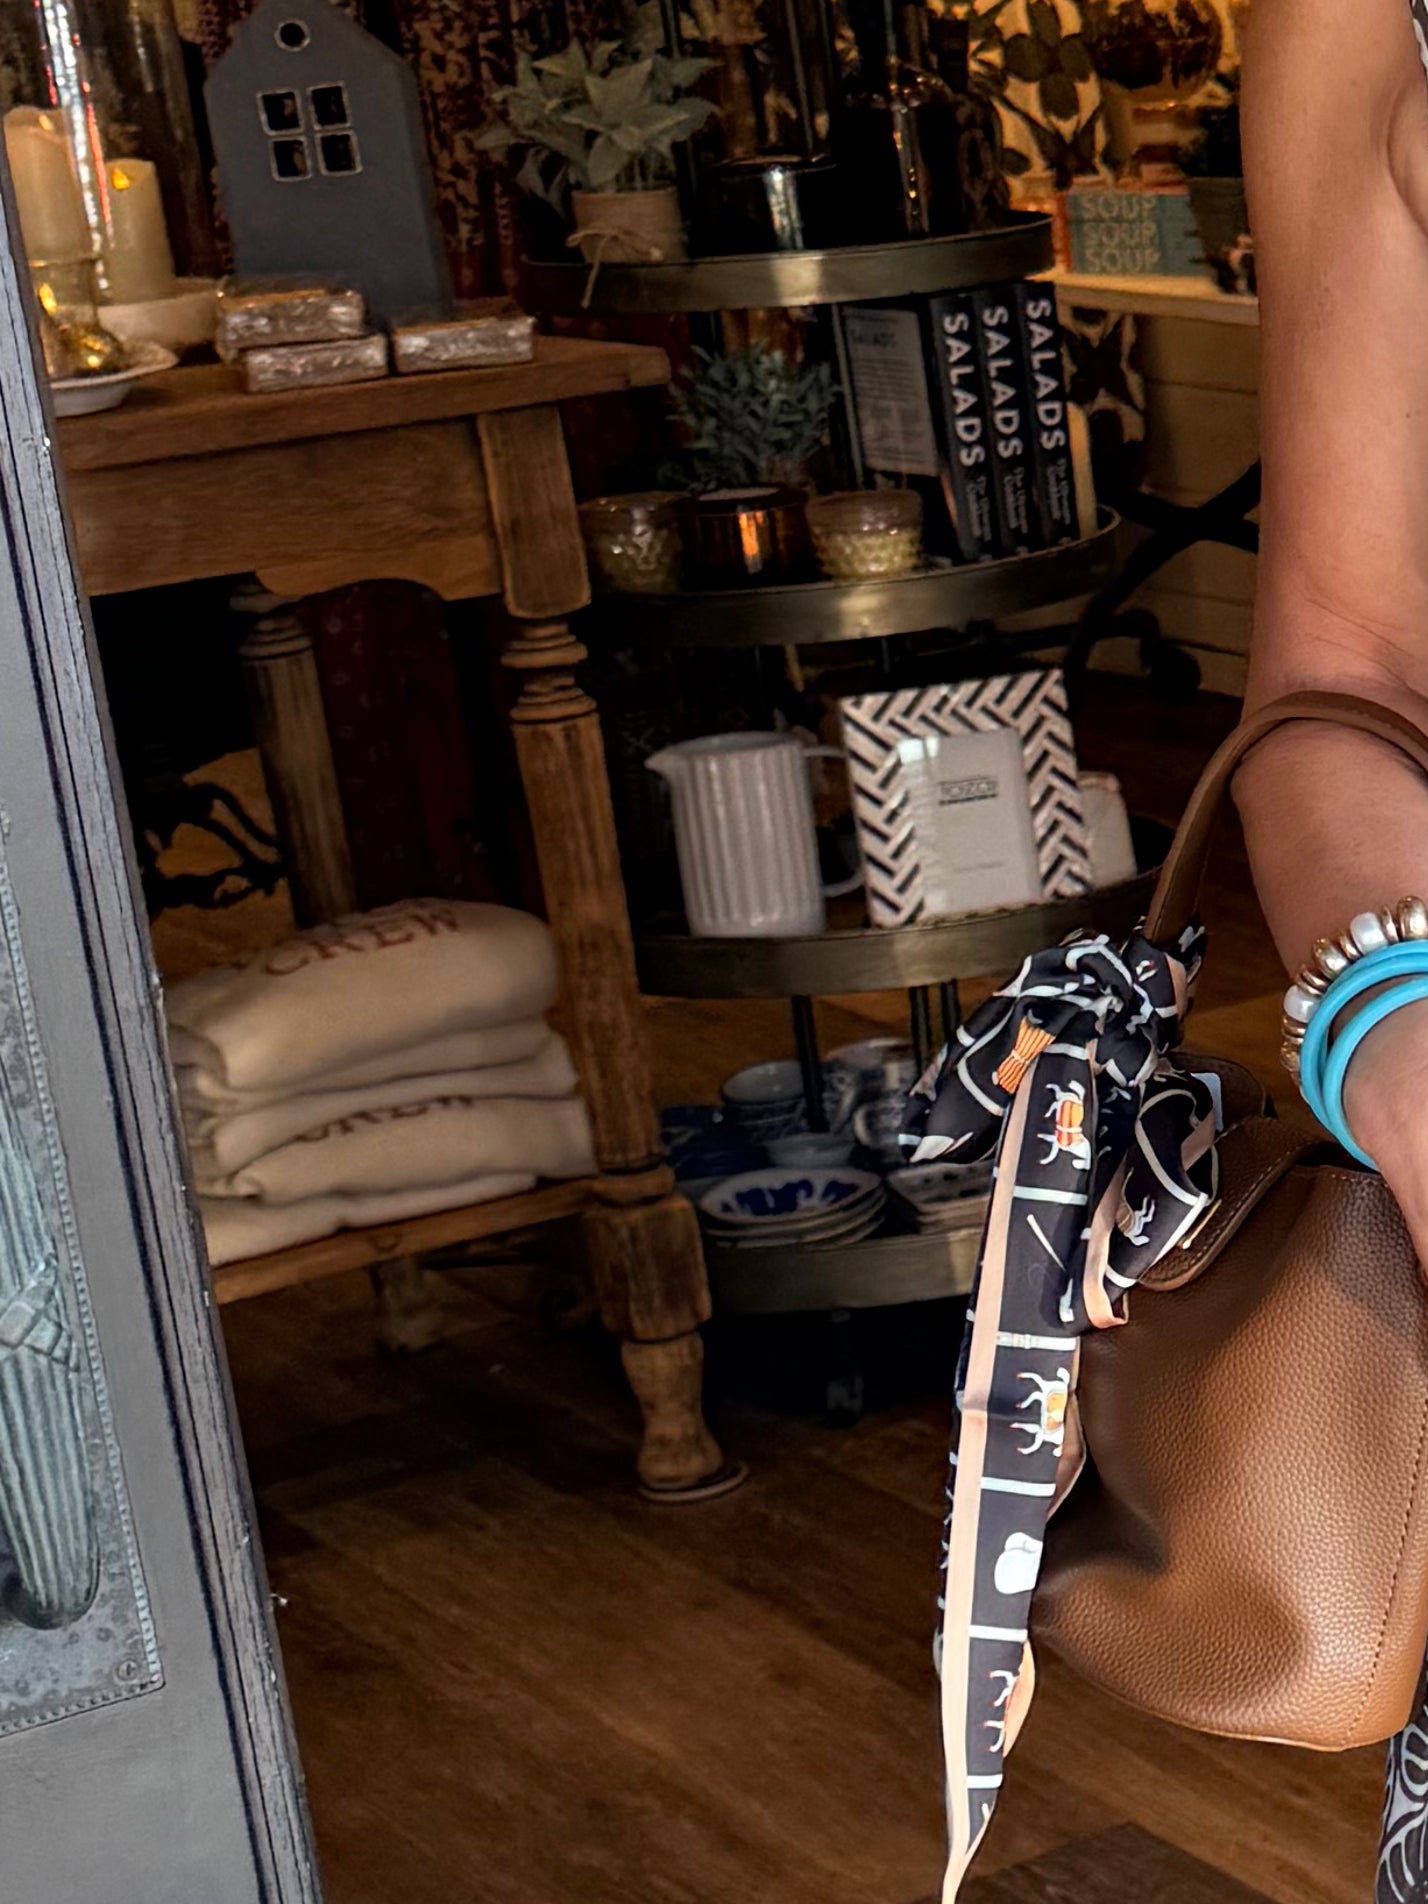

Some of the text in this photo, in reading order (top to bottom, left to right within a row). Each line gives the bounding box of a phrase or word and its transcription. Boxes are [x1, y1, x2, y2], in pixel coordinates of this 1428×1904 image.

[1081, 194, 1156, 218] SOUP
[1083, 222, 1158, 245] SOUP
[1086, 249, 1160, 272] SOUP
[943, 311, 987, 467] SALADS
[982, 304, 1024, 459] SALADS
[1026, 297, 1067, 451] SALADS
